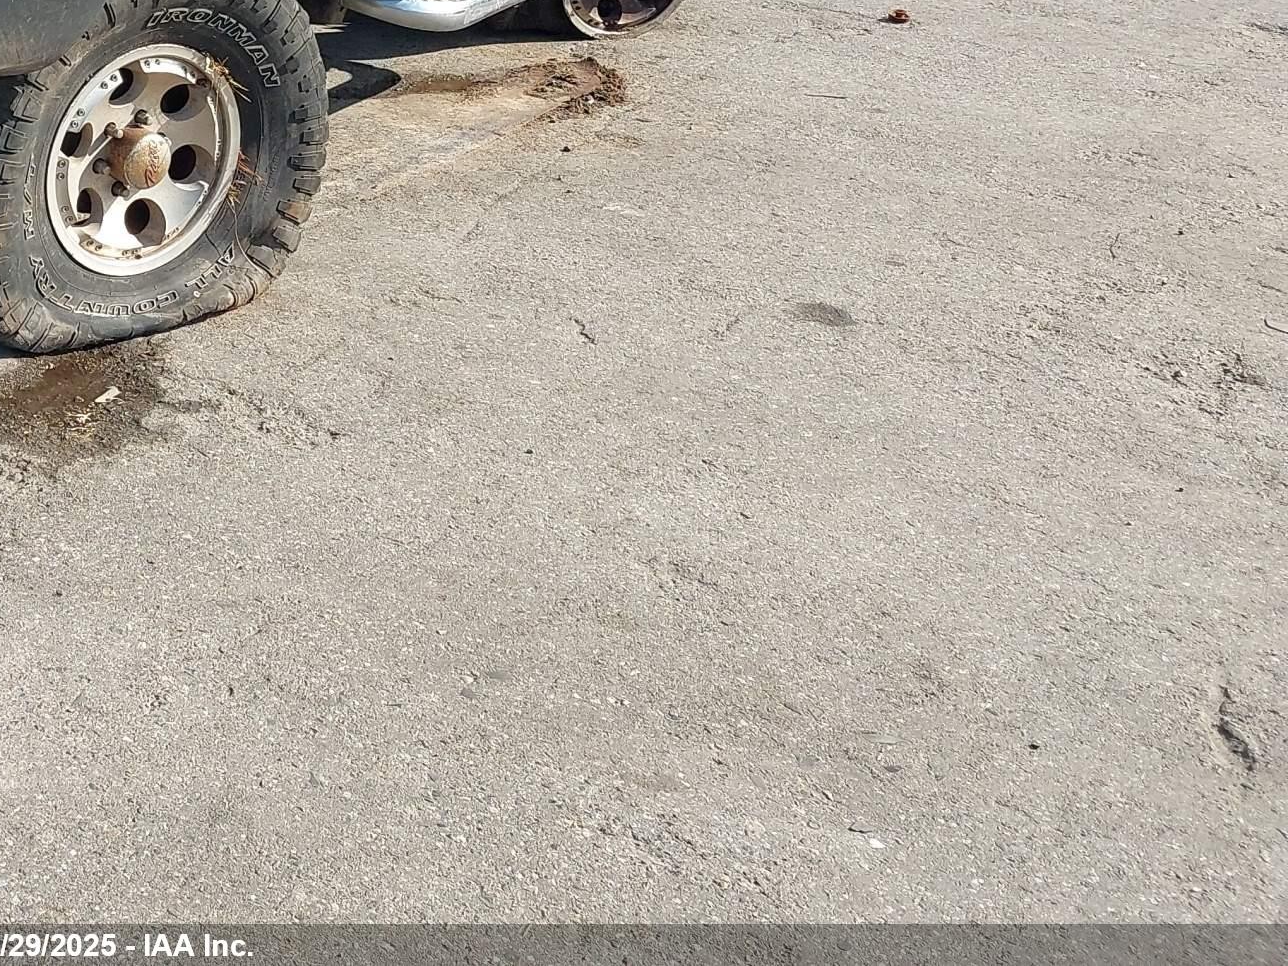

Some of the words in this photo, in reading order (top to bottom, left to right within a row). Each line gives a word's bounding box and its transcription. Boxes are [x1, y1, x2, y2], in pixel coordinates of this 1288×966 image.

[146, 7, 281, 88] IRONMAN
[28, 255, 180, 317] COUNTRY
[184, 242, 236, 290] ALL
